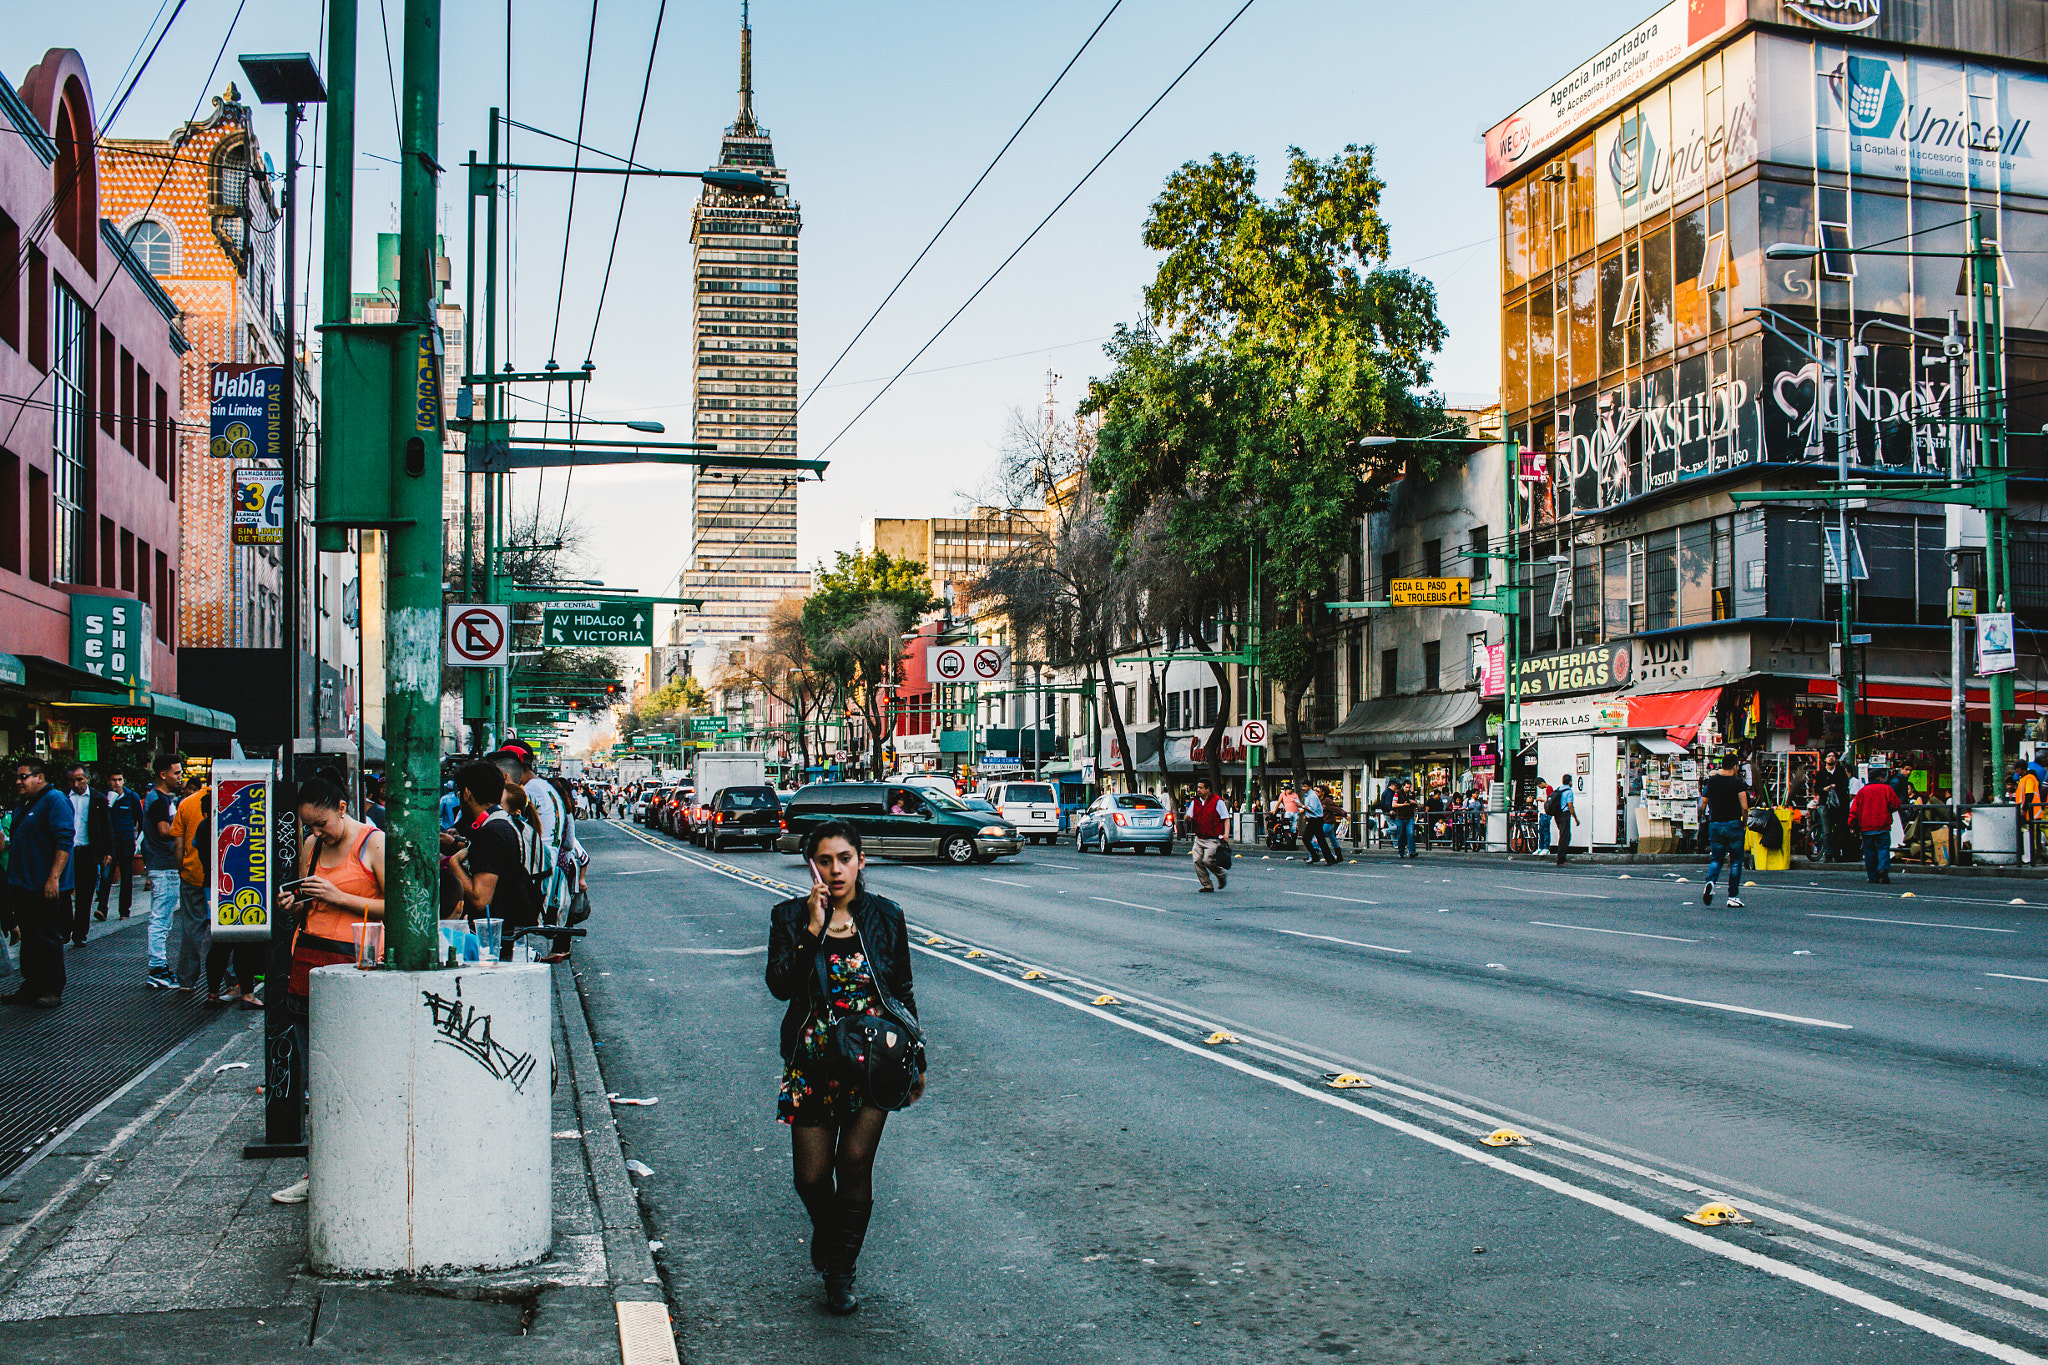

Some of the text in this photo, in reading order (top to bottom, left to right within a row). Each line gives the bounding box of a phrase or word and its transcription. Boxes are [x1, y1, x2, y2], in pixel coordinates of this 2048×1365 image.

[1550, 24, 1658, 107] Agencia Importadora
[1557, 50, 1650, 118] de Accesorios para Celular
[1500, 121, 1531, 157] WECAN
[1900, 105, 2031, 156] Unicell
[1652, 102, 1745, 195] Unicell
[1851, 141, 1862, 152] La
[1864, 143, 1897, 157] Capital
[1917, 151, 1963, 164] accesorio
[1966, 157, 1987, 168] ara
[1989, 158, 2016, 170] ceular
[213, 371, 266, 398] Habla
[212, 403, 263, 417] sin Límites
[267, 383, 281, 454] MONEDAS
[237, 527, 253, 535] SIN
[238, 535, 250, 543] DE
[1393, 581, 1446, 591] CEDA EL PASO
[1394, 593, 1447, 602] AL TROLEBUS
[553, 615, 625, 626] AV HIDALGO
[111, 606, 126, 683] SHO
[573, 630, 645, 642] VICTORIA
[1511, 648, 1610, 676] ZAPATERIAS
[1641, 638, 1690, 666] ADN
[1510, 663, 1609, 696] LAS VEGAS
[111, 716, 147, 727] SEX SHOP
[111, 725, 147, 735] CABINAS
[1520, 717, 1569, 727] APATERIA
[1571, 714, 1590, 725] LAS
[249, 788, 266, 882] MONEDAS
